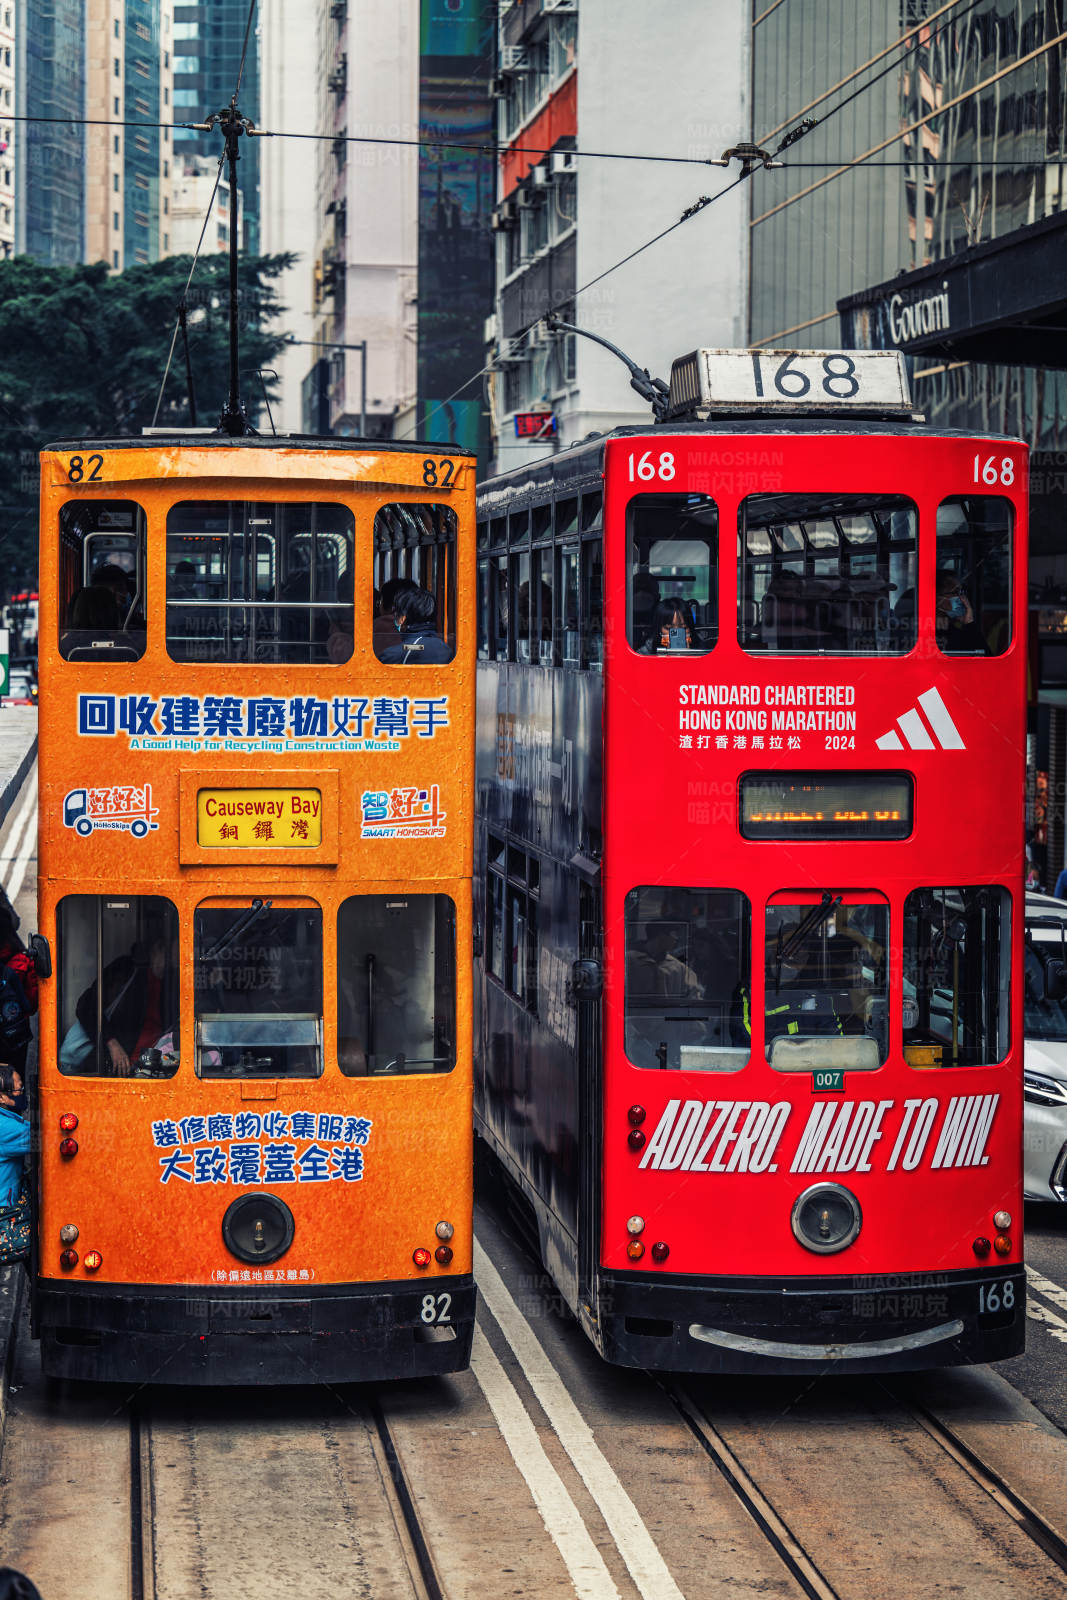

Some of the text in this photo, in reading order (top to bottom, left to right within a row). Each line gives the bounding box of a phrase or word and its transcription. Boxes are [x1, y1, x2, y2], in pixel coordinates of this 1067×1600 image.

[890, 281, 950, 344] Gourami
[752, 352, 859, 398] 168
[68, 454, 104, 482] 82
[423, 459, 454, 487] 82
[629, 451, 675, 482] 168
[974, 454, 1014, 486] 168
[679, 685, 856, 706] STANDARD CHARTERED
[79, 695, 448, 737] 回收建築廢物好幫手
[679, 710, 857, 731] HONG KONG MARATHON
[130, 740, 400, 752] A Good Help for Recycling Construction Waste
[679, 734, 856, 750] 渣打香港馬拉松 2024
[205, 796, 320, 819] Causeway Bay
[93, 821, 130, 830] HoHoSkips
[218, 819, 309, 841] 銅鑼灣
[362, 828, 444, 837] SMART HOHOSKIPS
[816, 1072, 841, 1086] 007
[152, 1111, 372, 1147] 裝修廢物收集服務
[638, 1094, 1000, 1173] ADIZERO. MADE TO WIN.
[160, 1143, 364, 1184] 大致覆蓋全港
[421, 1293, 451, 1322] 82
[979, 1281, 1015, 1313] 168
